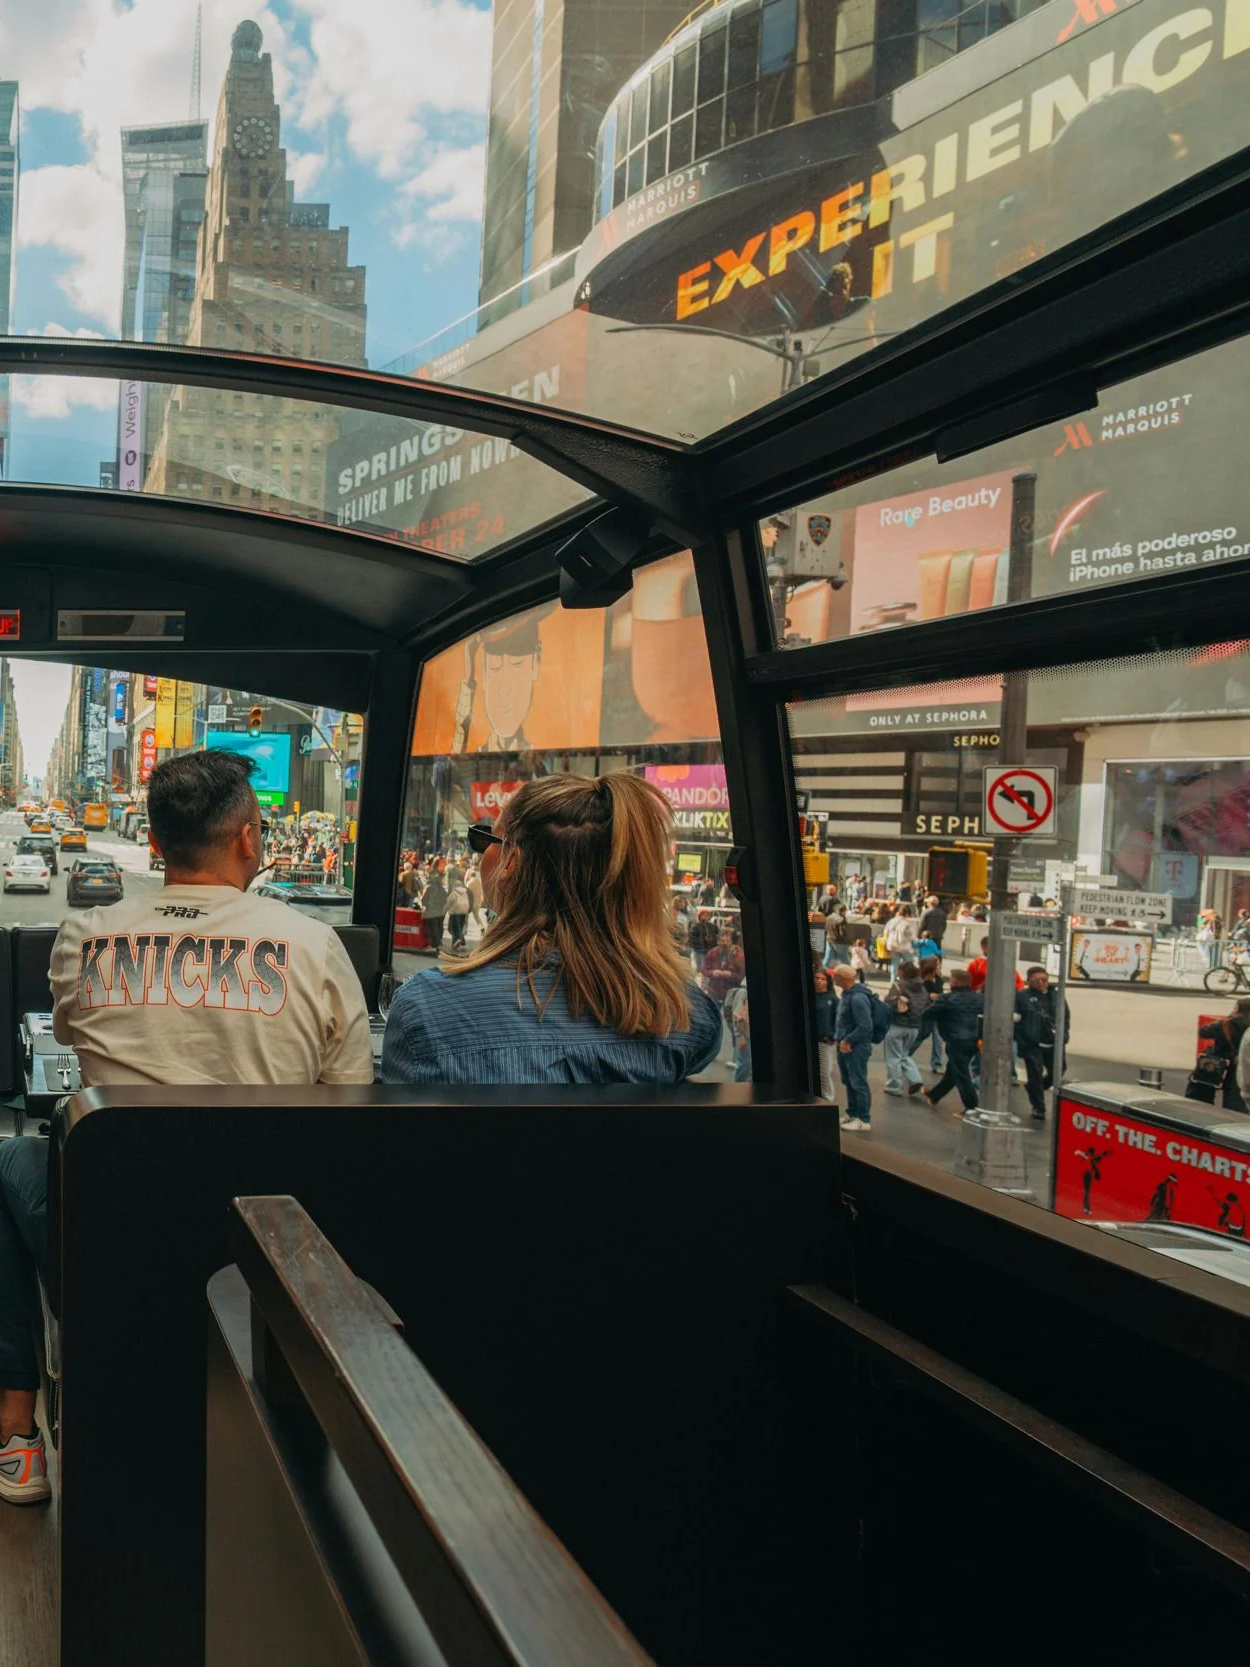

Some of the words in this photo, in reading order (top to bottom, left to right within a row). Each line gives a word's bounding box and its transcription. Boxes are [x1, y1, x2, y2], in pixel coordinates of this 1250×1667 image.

[871, 211, 954, 300] IT
[1101, 412, 1181, 441] MARQUIS
[1102, 394, 1193, 427] MARRIOTT
[337, 487, 387, 526] DELIVER
[394, 474, 413, 507] ME
[421, 454, 462, 495] FROM
[880, 504, 923, 528] Rare
[928, 487, 1001, 517] Beauty
[1070, 549, 1088, 564] El
[1092, 541, 1132, 561] más
[1137, 526, 1238, 555] poderoso
[1069, 561, 1135, 582] iPhone
[1139, 550, 1197, 572] hasta
[870, 715, 901, 727] ONLY
[905, 713, 920, 724] AT
[926, 710, 988, 723] SEPHORA
[1080, 904, 1097, 914] KEEP
[1100, 905, 1128, 917] MOVING
[1081, 892, 1124, 904] PEDESTRIAN
[1126, 896, 1146, 906] FLOW
[1148, 898, 1167, 908] ZONE
[77, 933, 289, 1016] KNICKS
[1072, 1111, 1112, 1139] OFF.
[1114, 1124, 1162, 1156] THE.
